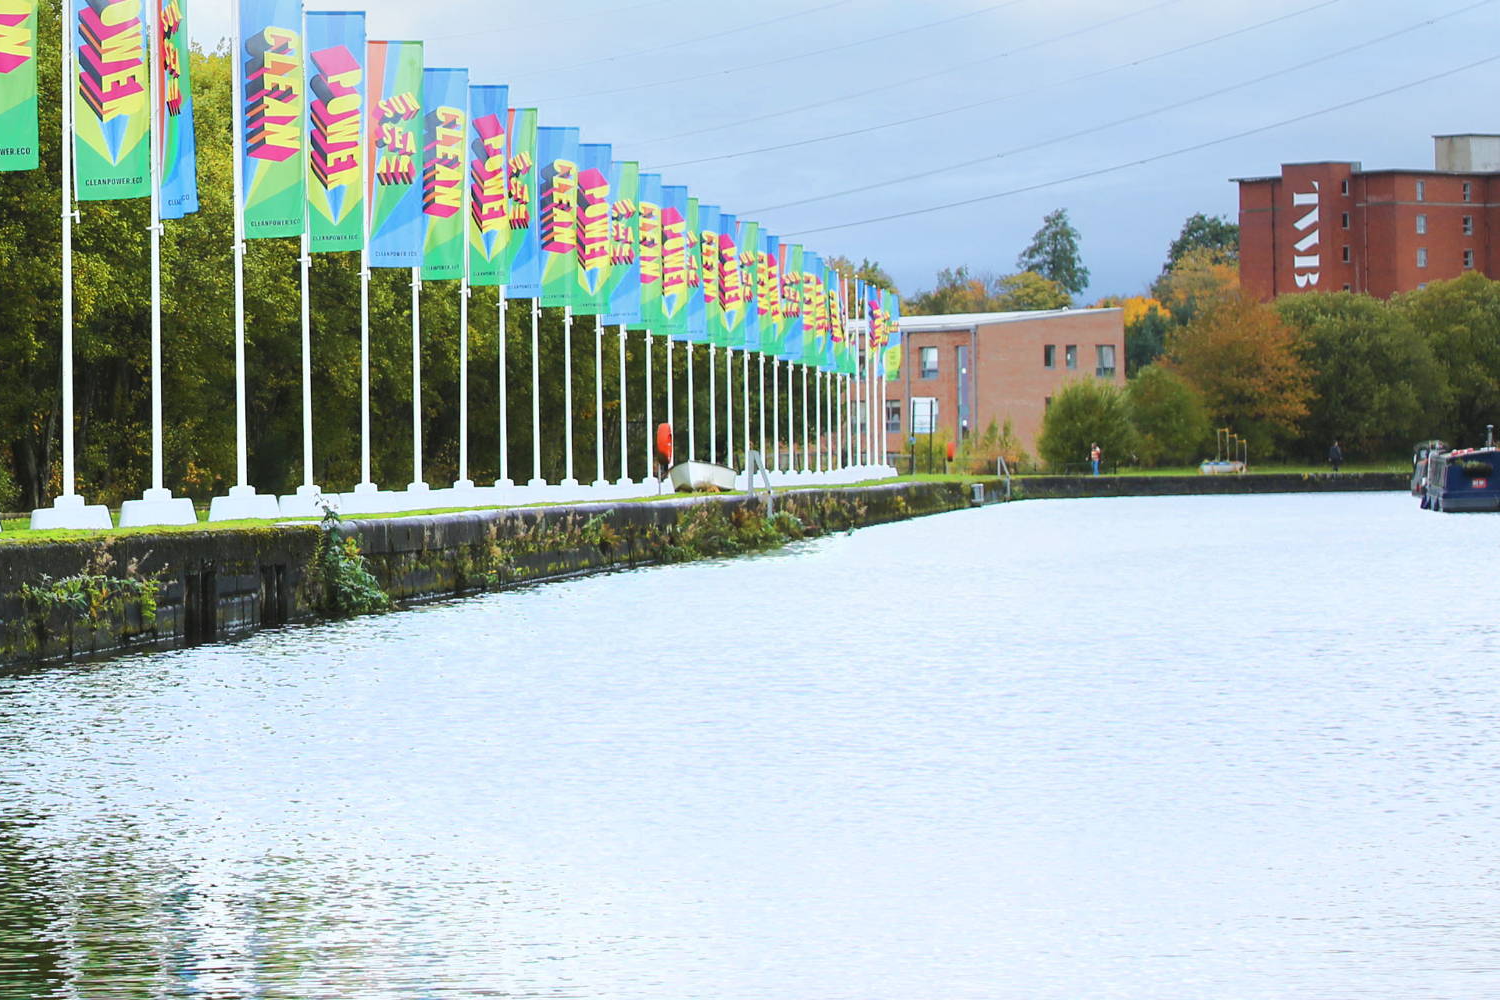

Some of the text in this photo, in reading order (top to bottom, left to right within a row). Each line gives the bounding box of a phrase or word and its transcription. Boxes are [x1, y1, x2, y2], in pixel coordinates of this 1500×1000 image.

[254, 26, 301, 155] CLEAN
[319, 57, 362, 190] POWER
[375, 92, 420, 121] SUN
[377, 155, 414, 179] AIR
[379, 122, 416, 154] SEA
[429, 106, 465, 212] CLEAN
[508, 151, 532, 174] SUN
[85, 176, 143, 187] CLEANPOWER.ECO
[477, 124, 507, 234] POWER
[509, 178, 529, 204] SEA
[547, 159, 577, 249] CLEAN
[611, 198, 636, 219] SUN
[581, 176, 610, 271] POWER
[611, 221, 634, 243] SEA
[639, 201, 661, 279] CLEAN
[663, 213, 686, 296] POWER
[720, 240, 740, 311] POWER
